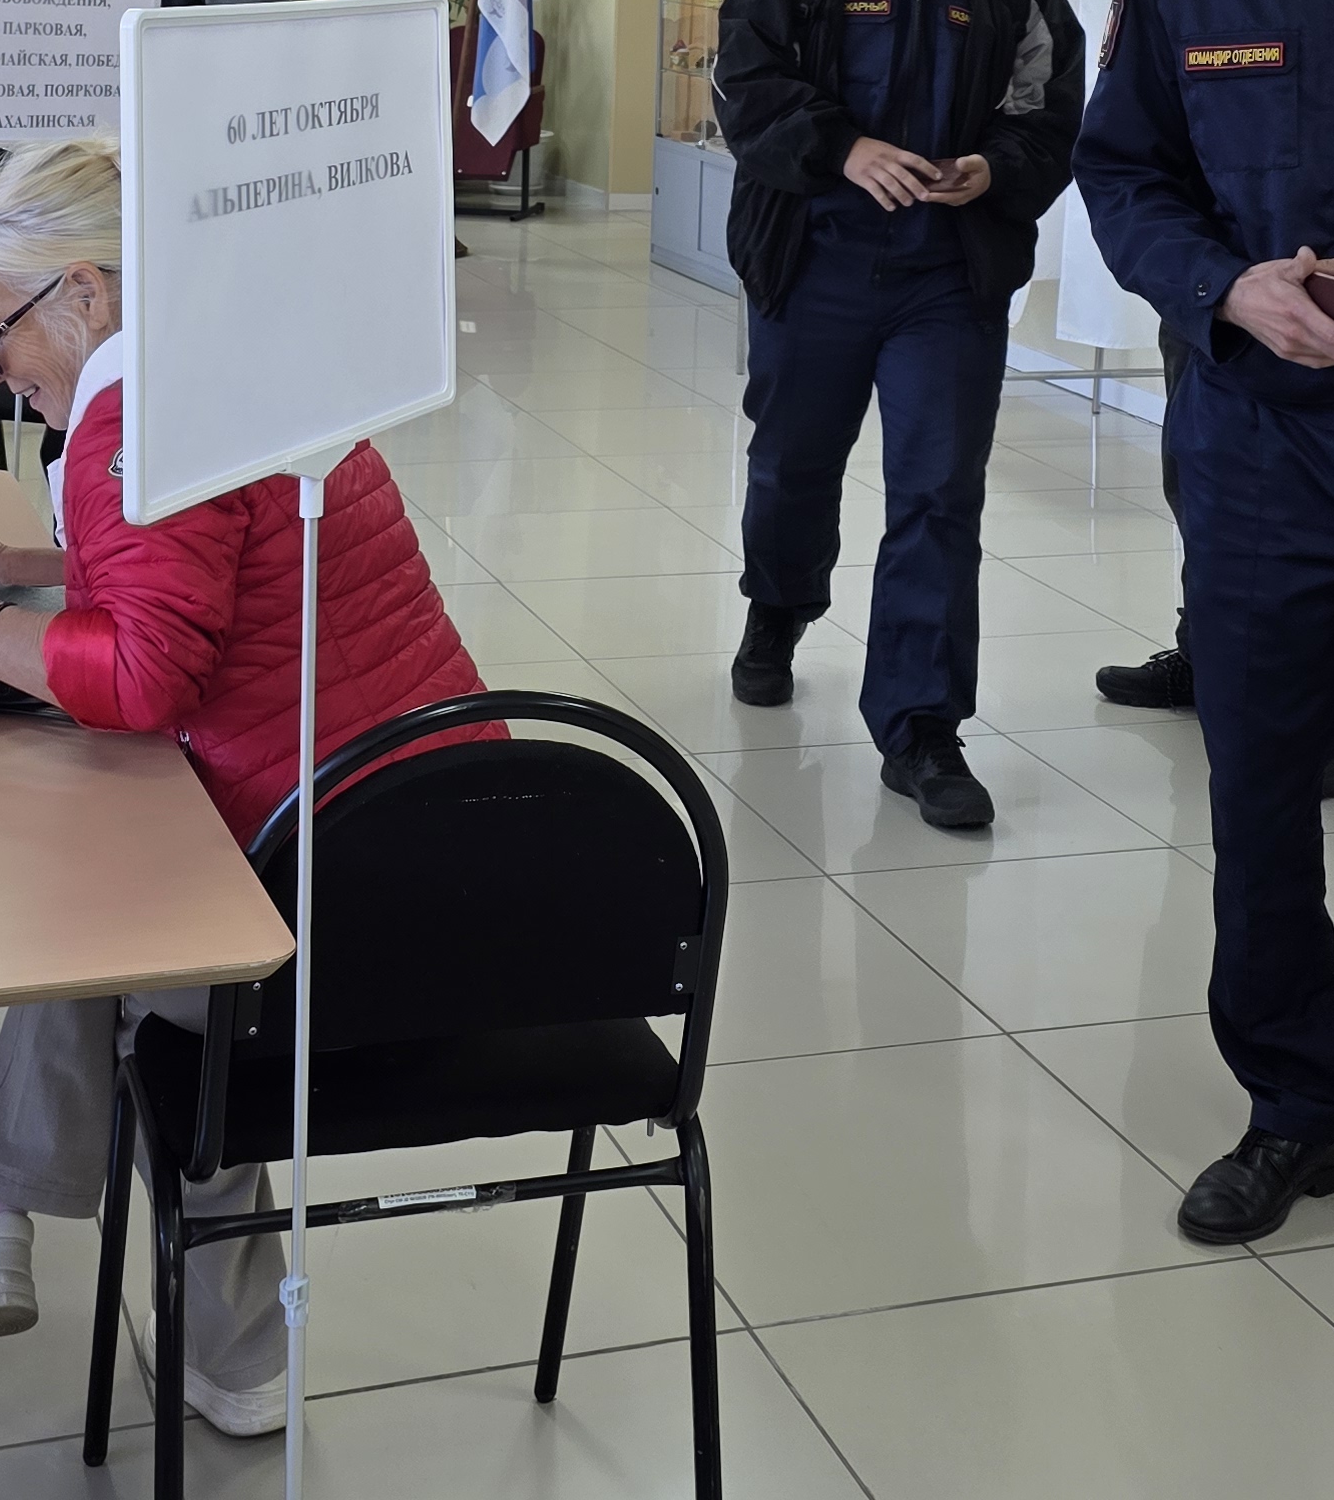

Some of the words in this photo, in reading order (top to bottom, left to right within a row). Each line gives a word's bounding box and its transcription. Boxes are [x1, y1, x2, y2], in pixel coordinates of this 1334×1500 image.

[2, 21, 87, 38] ПАРКОВАЯ,
[1188, 49, 1231, 66] КОМАНДИР
[1231, 47, 1279, 65] ОТДЕЛЕНИЯ
[227, 114, 247, 145] 60
[252, 107, 292, 141] ЛЕТ
[296, 92, 380, 132] ОКТЯБРЯ
[186, 169, 323, 223] АЛЬПЕРИНА,
[327, 150, 413, 192] ВИЛКОВА
